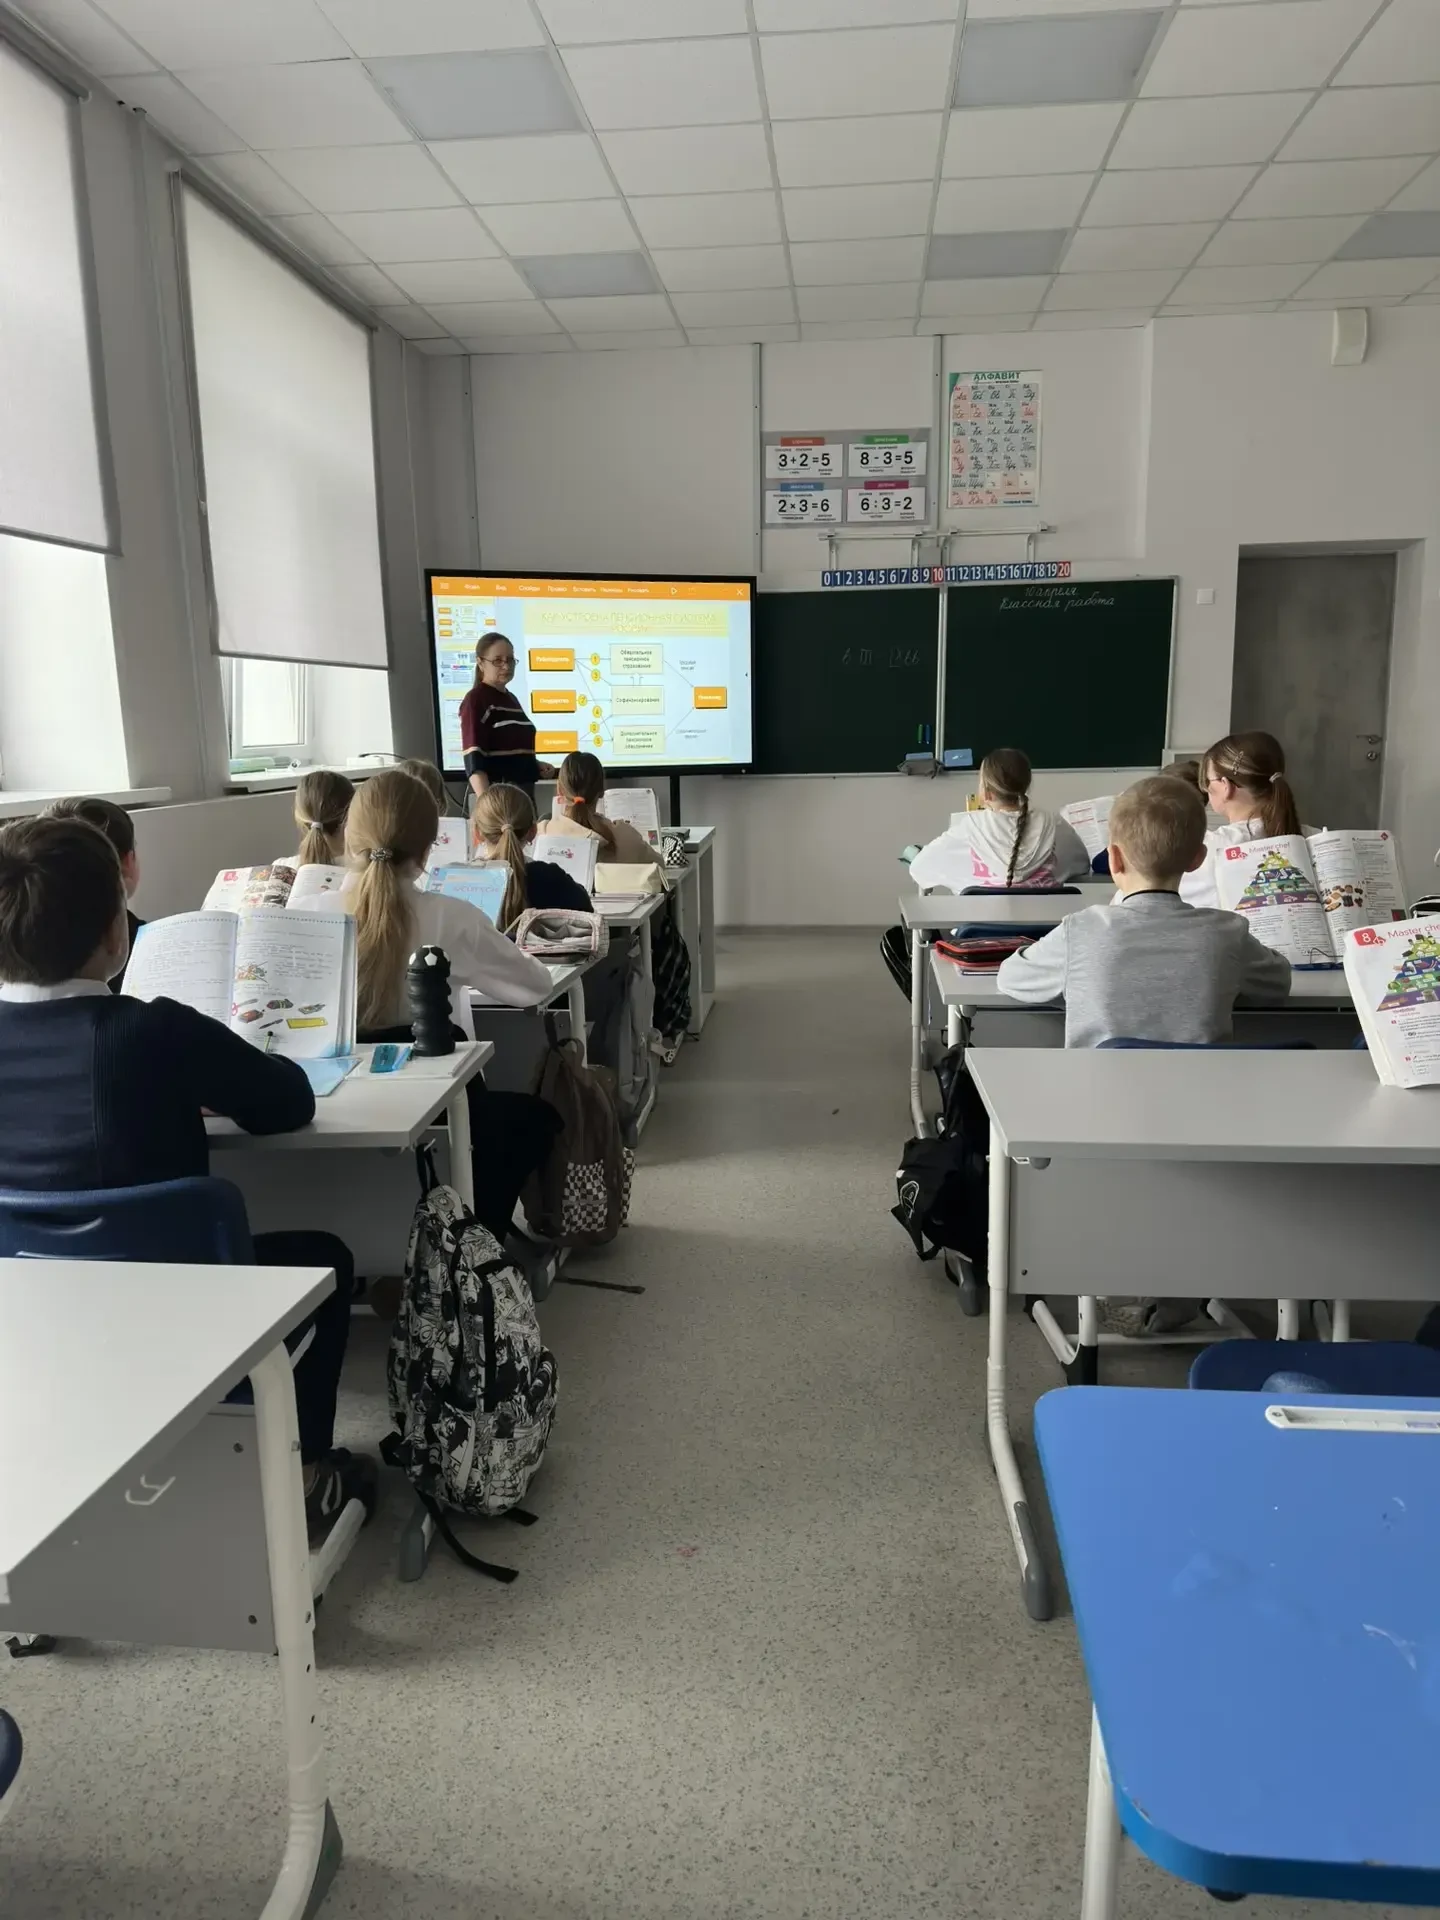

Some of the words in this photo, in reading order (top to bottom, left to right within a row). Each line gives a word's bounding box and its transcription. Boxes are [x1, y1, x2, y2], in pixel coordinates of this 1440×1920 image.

[973, 372, 1020, 381] АЛФАВИТ
[778, 453, 788, 467] 3
[799, 453, 809, 467] 2
[821, 453, 831, 467] 5
[860, 451, 870, 466] 8
[883, 451, 893, 465] 3
[903, 450, 913, 464] 5
[778, 499, 787, 513] 2
[799, 499, 808, 512] 3
[820, 498, 830, 512] 6
[860, 497, 870, 511] 6
[882, 497, 891, 510] 3
[903, 496, 912, 510] 2
[823, 572, 831, 586] 0
[835, 572, 841, 585] 1
[845, 571, 853, 584] 2
[856, 571, 863, 584] 3
[867, 571, 875, 584] 4
[878, 570, 885, 584] 5
[889, 570, 896, 583] 6
[900, 569, 907, 583] 7
[911, 569, 919, 582] 8
[922, 568, 930, 582] 9
[932, 568, 944, 582] 10
[945, 567, 956, 581] 11
[958, 567, 969, 580] 12
[971, 566, 982, 580] 13
[983, 566, 994, 579] 14
[996, 565, 1007, 579] 15
[1008, 565, 1019, 579] 16
[1021, 564, 1032, 578] 17
[1034, 563, 1045, 577] 18
[1047, 563, 1057, 577] 19
[1058, 562, 1070, 576] 20
[1000, 597, 1060, 611] Классная
[1064, 591, 1115, 612] работа
[1230, 849, 1237, 858] 8
[1361, 932, 1371, 943] 8
[1388, 927, 1421, 938] Master
